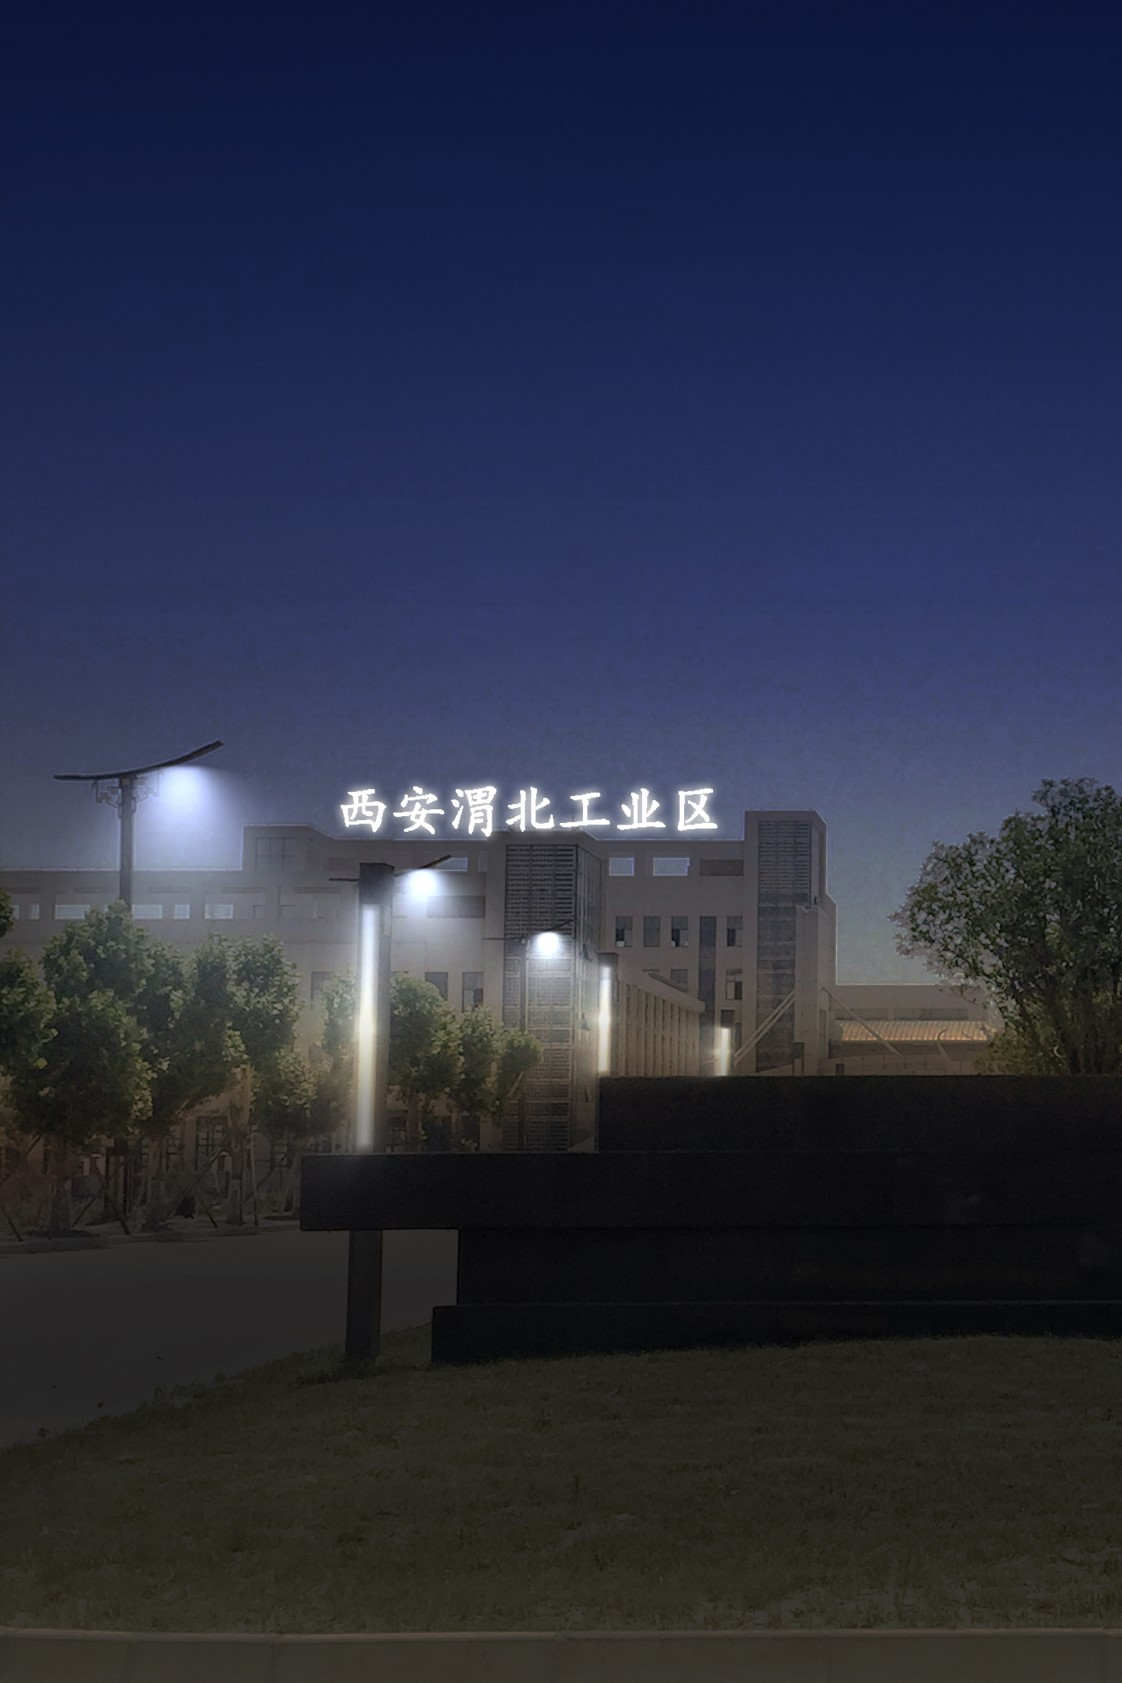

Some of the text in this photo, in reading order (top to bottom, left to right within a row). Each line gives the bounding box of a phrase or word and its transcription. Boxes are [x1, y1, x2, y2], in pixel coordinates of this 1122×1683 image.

[340, 785, 718, 838] 西安渭北工业区
